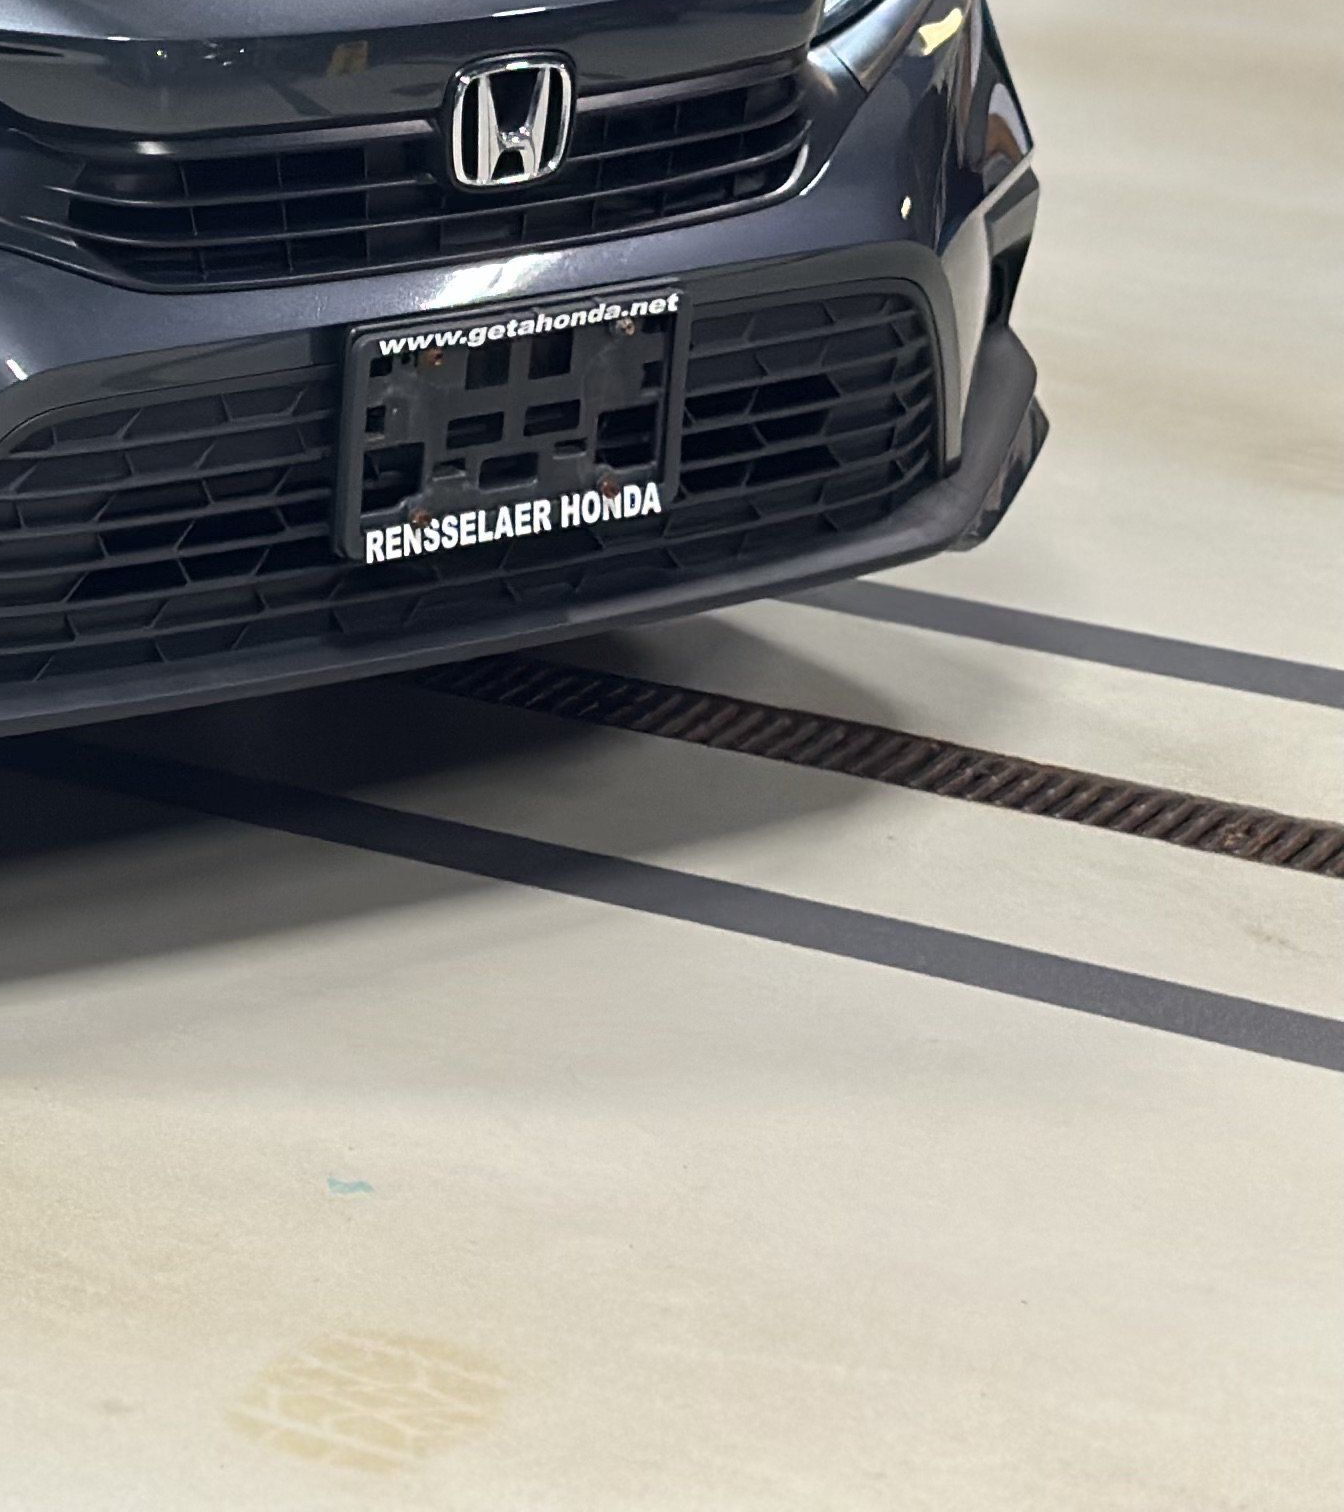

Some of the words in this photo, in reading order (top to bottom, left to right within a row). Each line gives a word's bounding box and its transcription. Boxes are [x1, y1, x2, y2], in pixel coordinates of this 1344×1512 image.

[378, 292, 680, 356] www.getahonda.net
[365, 499, 553, 565] RENSSELAER
[560, 481, 663, 529] HONDA
